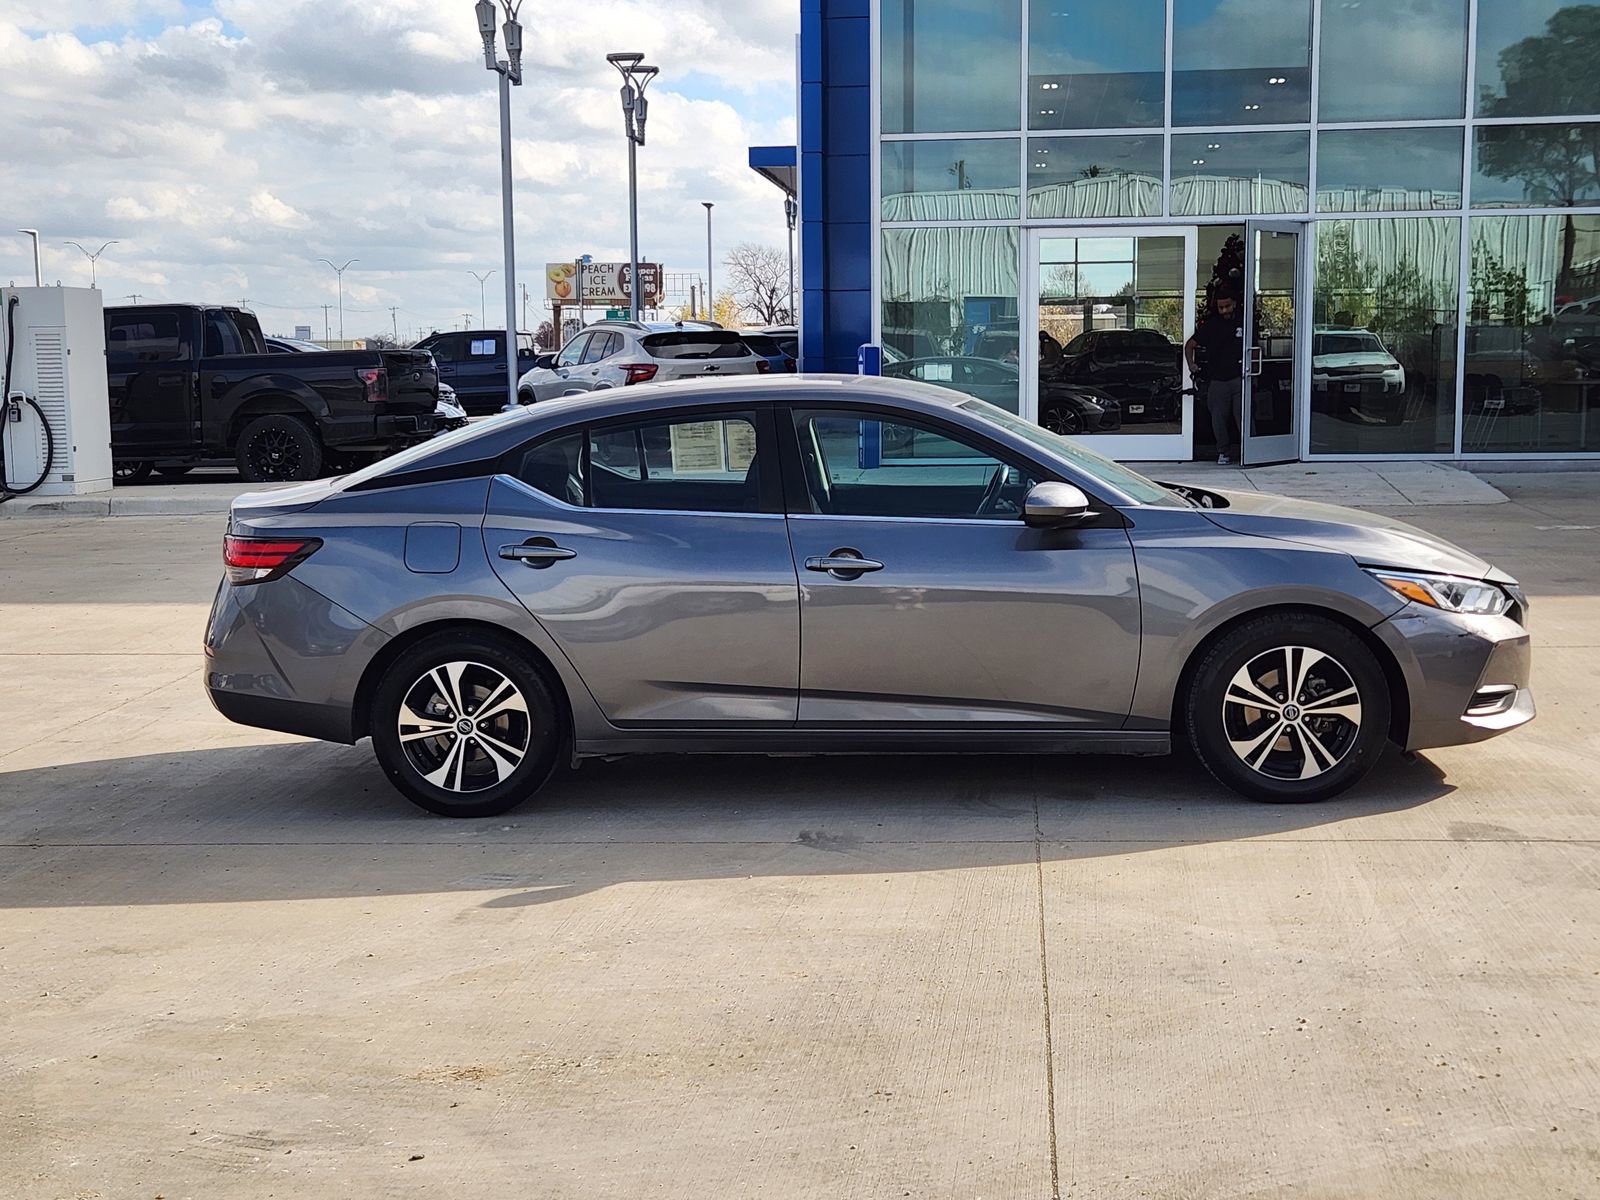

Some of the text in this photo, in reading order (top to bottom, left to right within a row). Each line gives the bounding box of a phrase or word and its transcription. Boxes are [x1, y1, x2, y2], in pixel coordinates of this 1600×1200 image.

[582, 264, 614, 273] PEACH
[623, 267, 656, 275] Cper
[590, 276, 606, 284] ICE
[582, 287, 616, 296] CREAM
